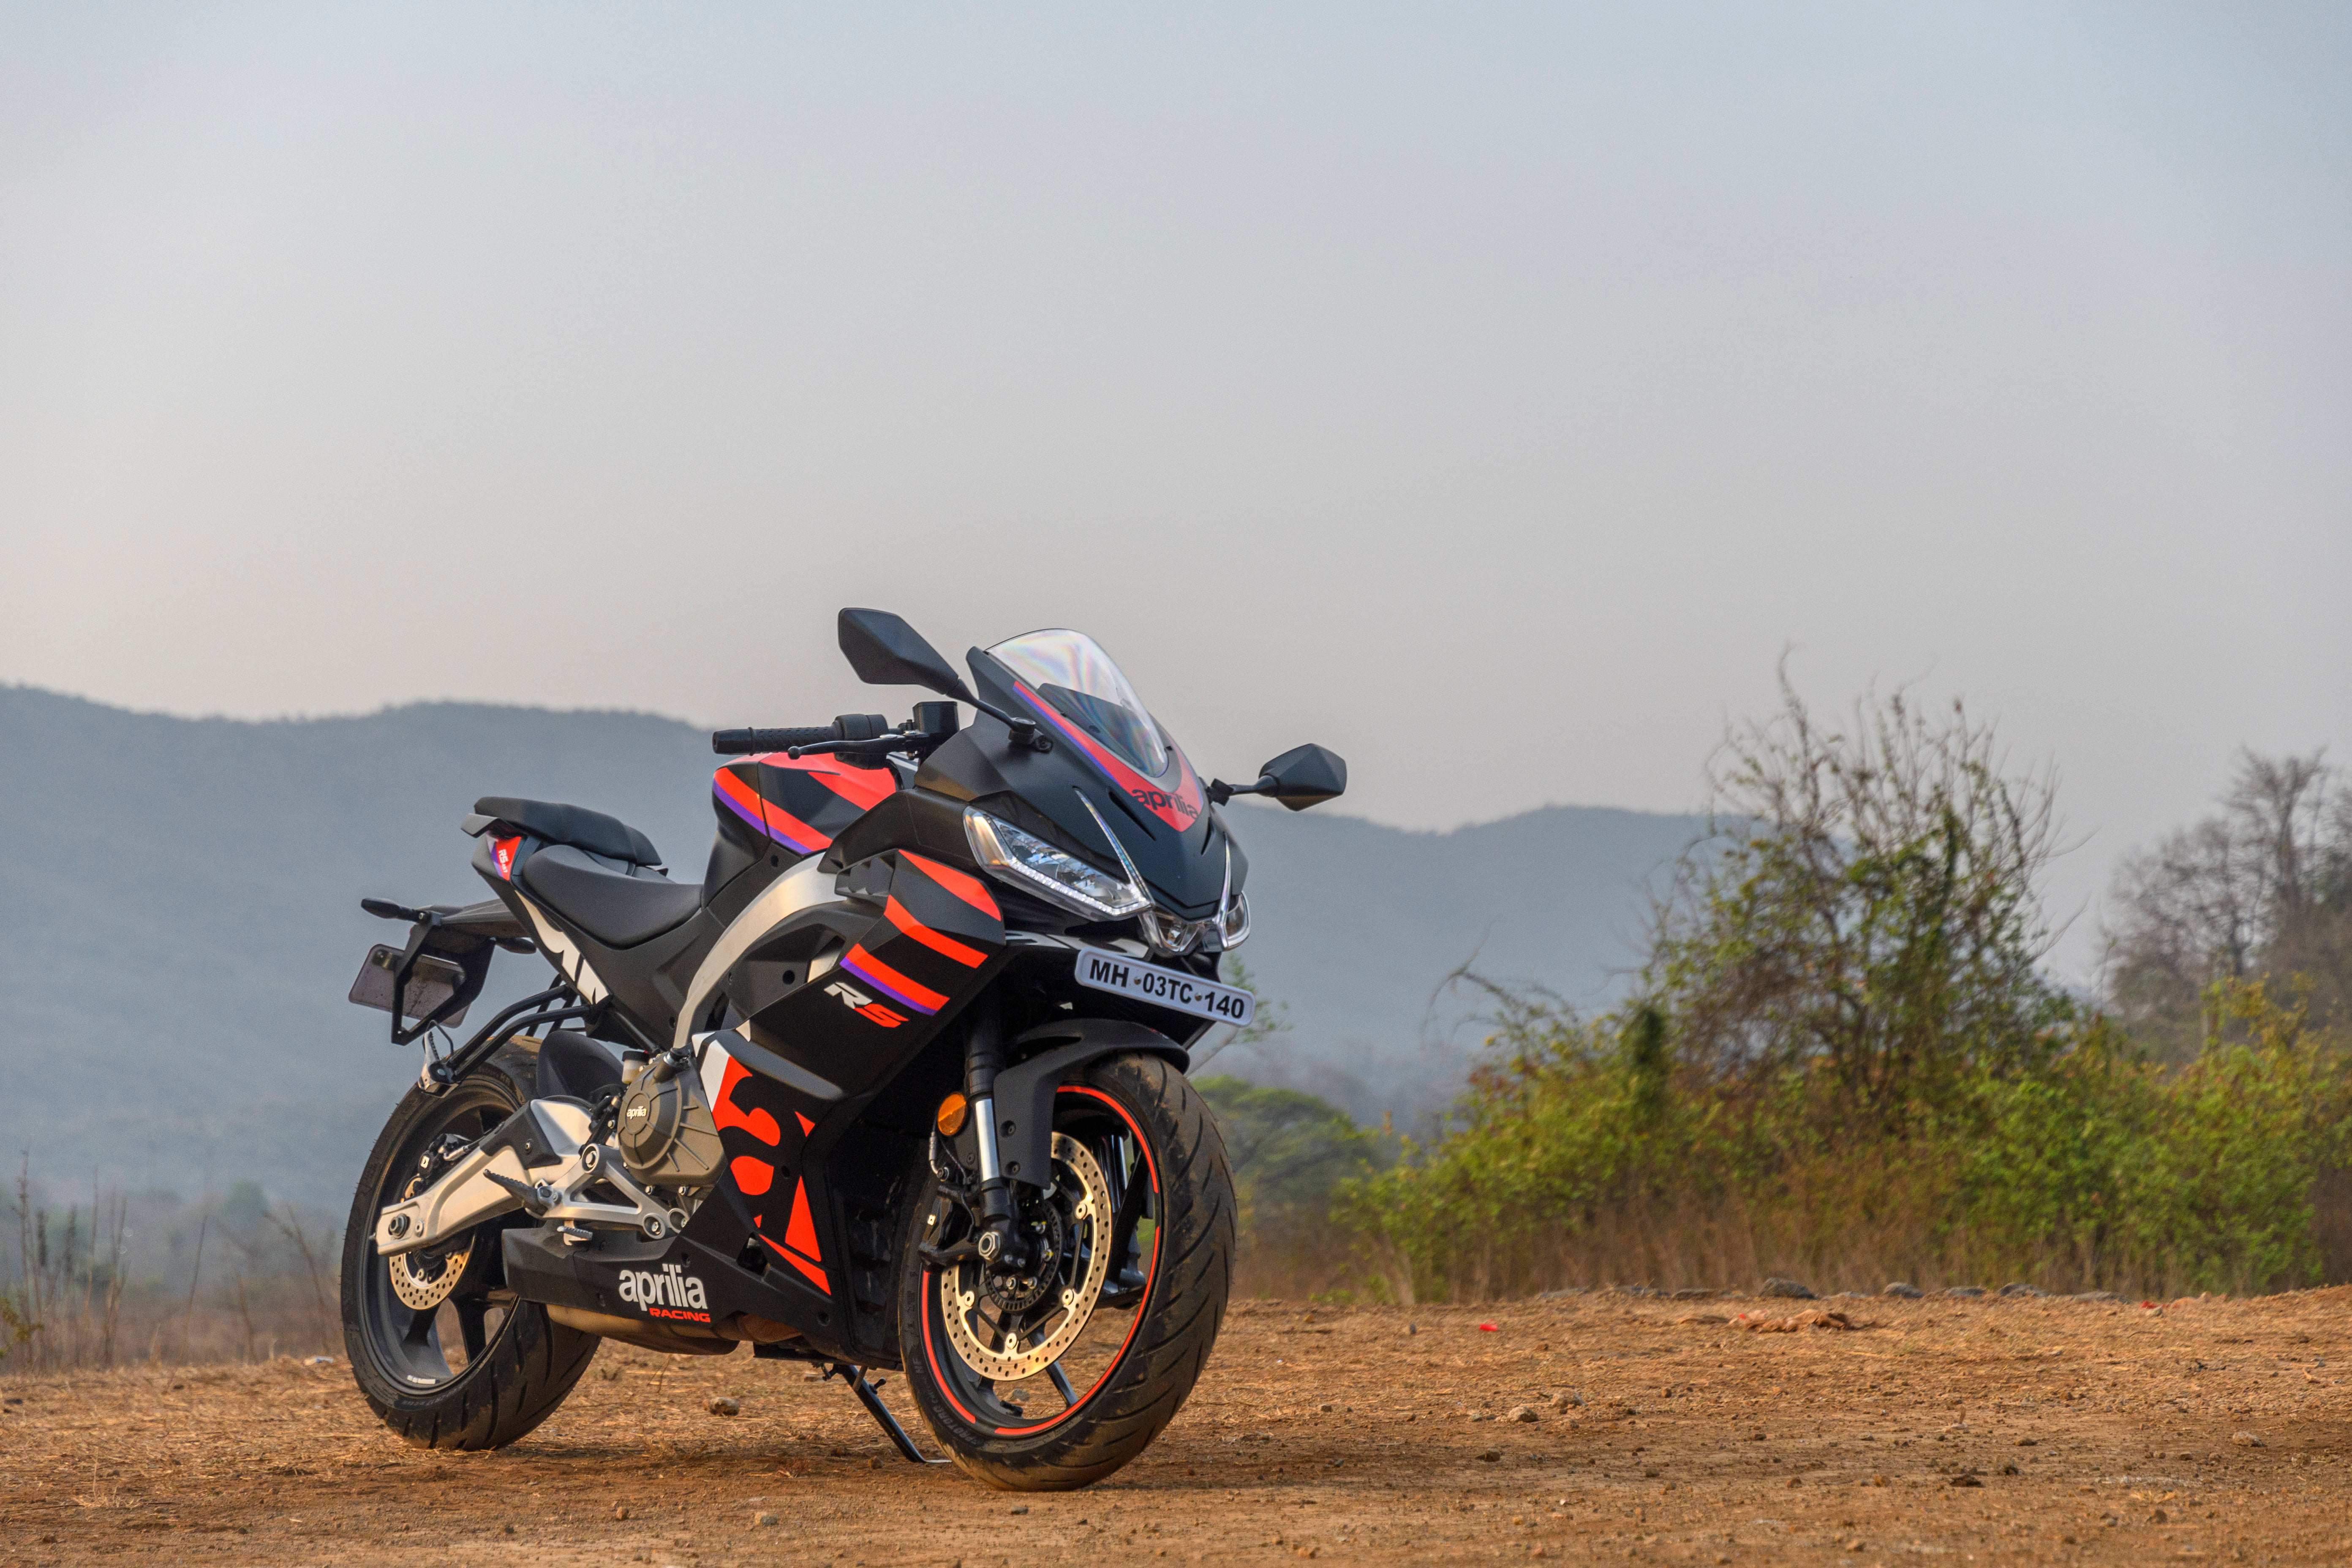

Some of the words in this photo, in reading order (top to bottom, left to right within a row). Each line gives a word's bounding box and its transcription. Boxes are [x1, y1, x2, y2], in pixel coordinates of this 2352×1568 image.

[1132, 789, 1199, 820] aprilia
[498, 849, 509, 863] RS
[824, 982, 909, 1028] RS
[1089, 959, 1129, 988] MH
[1143, 973, 1193, 1004] 03TC
[1204, 991, 1244, 1019] 140
[619, 1263, 708, 1311] aprilia
[649, 1308, 710, 1323] RACING
